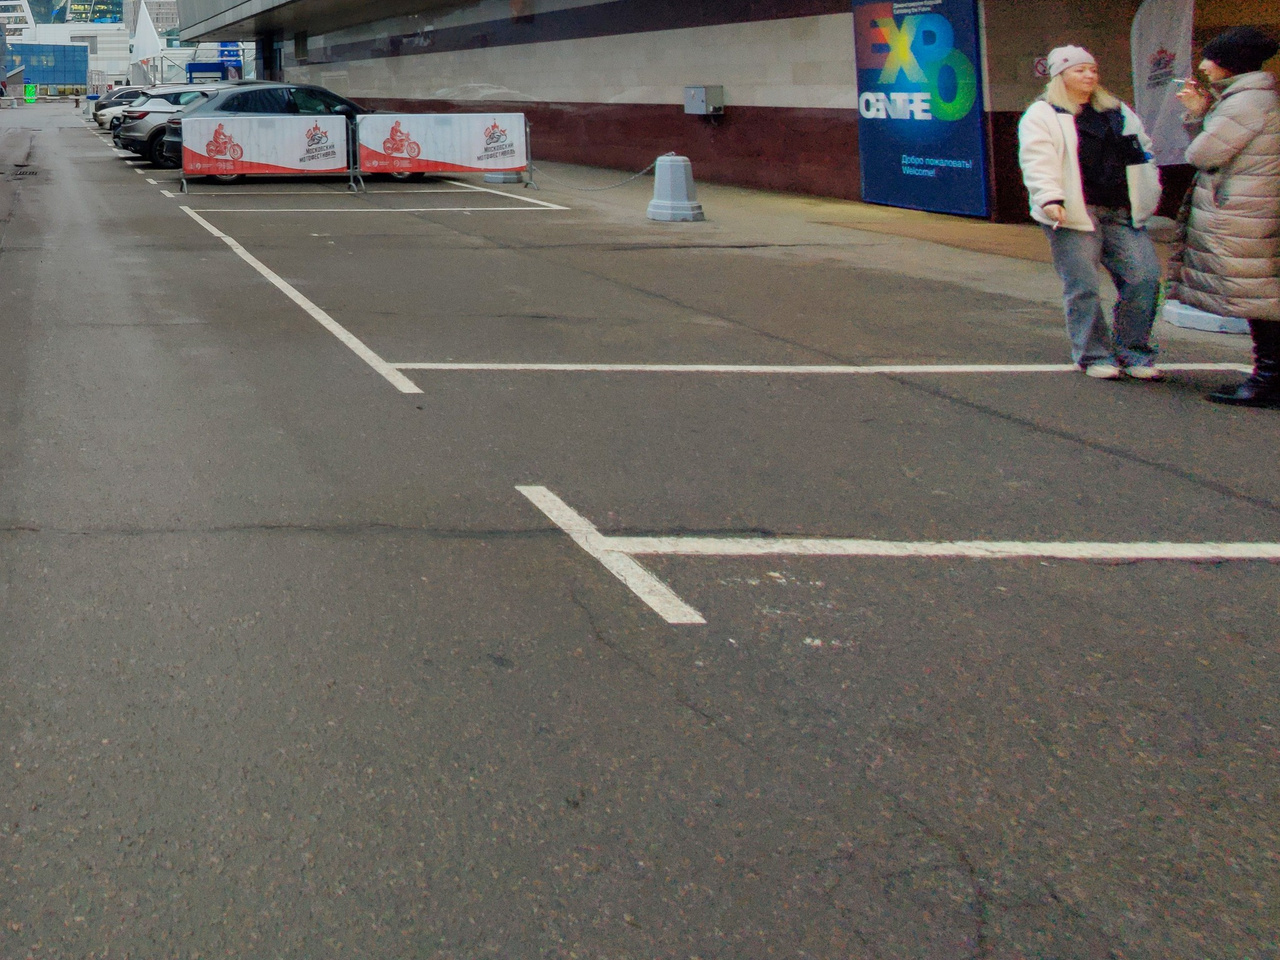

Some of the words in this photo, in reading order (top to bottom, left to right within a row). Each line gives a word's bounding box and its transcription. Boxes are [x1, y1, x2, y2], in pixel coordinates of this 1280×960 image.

[854, 2, 977, 121] EXPO
[859, 91, 932, 120] CENTRE
[902, 154, 924, 164] Добро
[925, 157, 972, 169] пожаловать!
[902, 166, 936, 177] Welcome!
